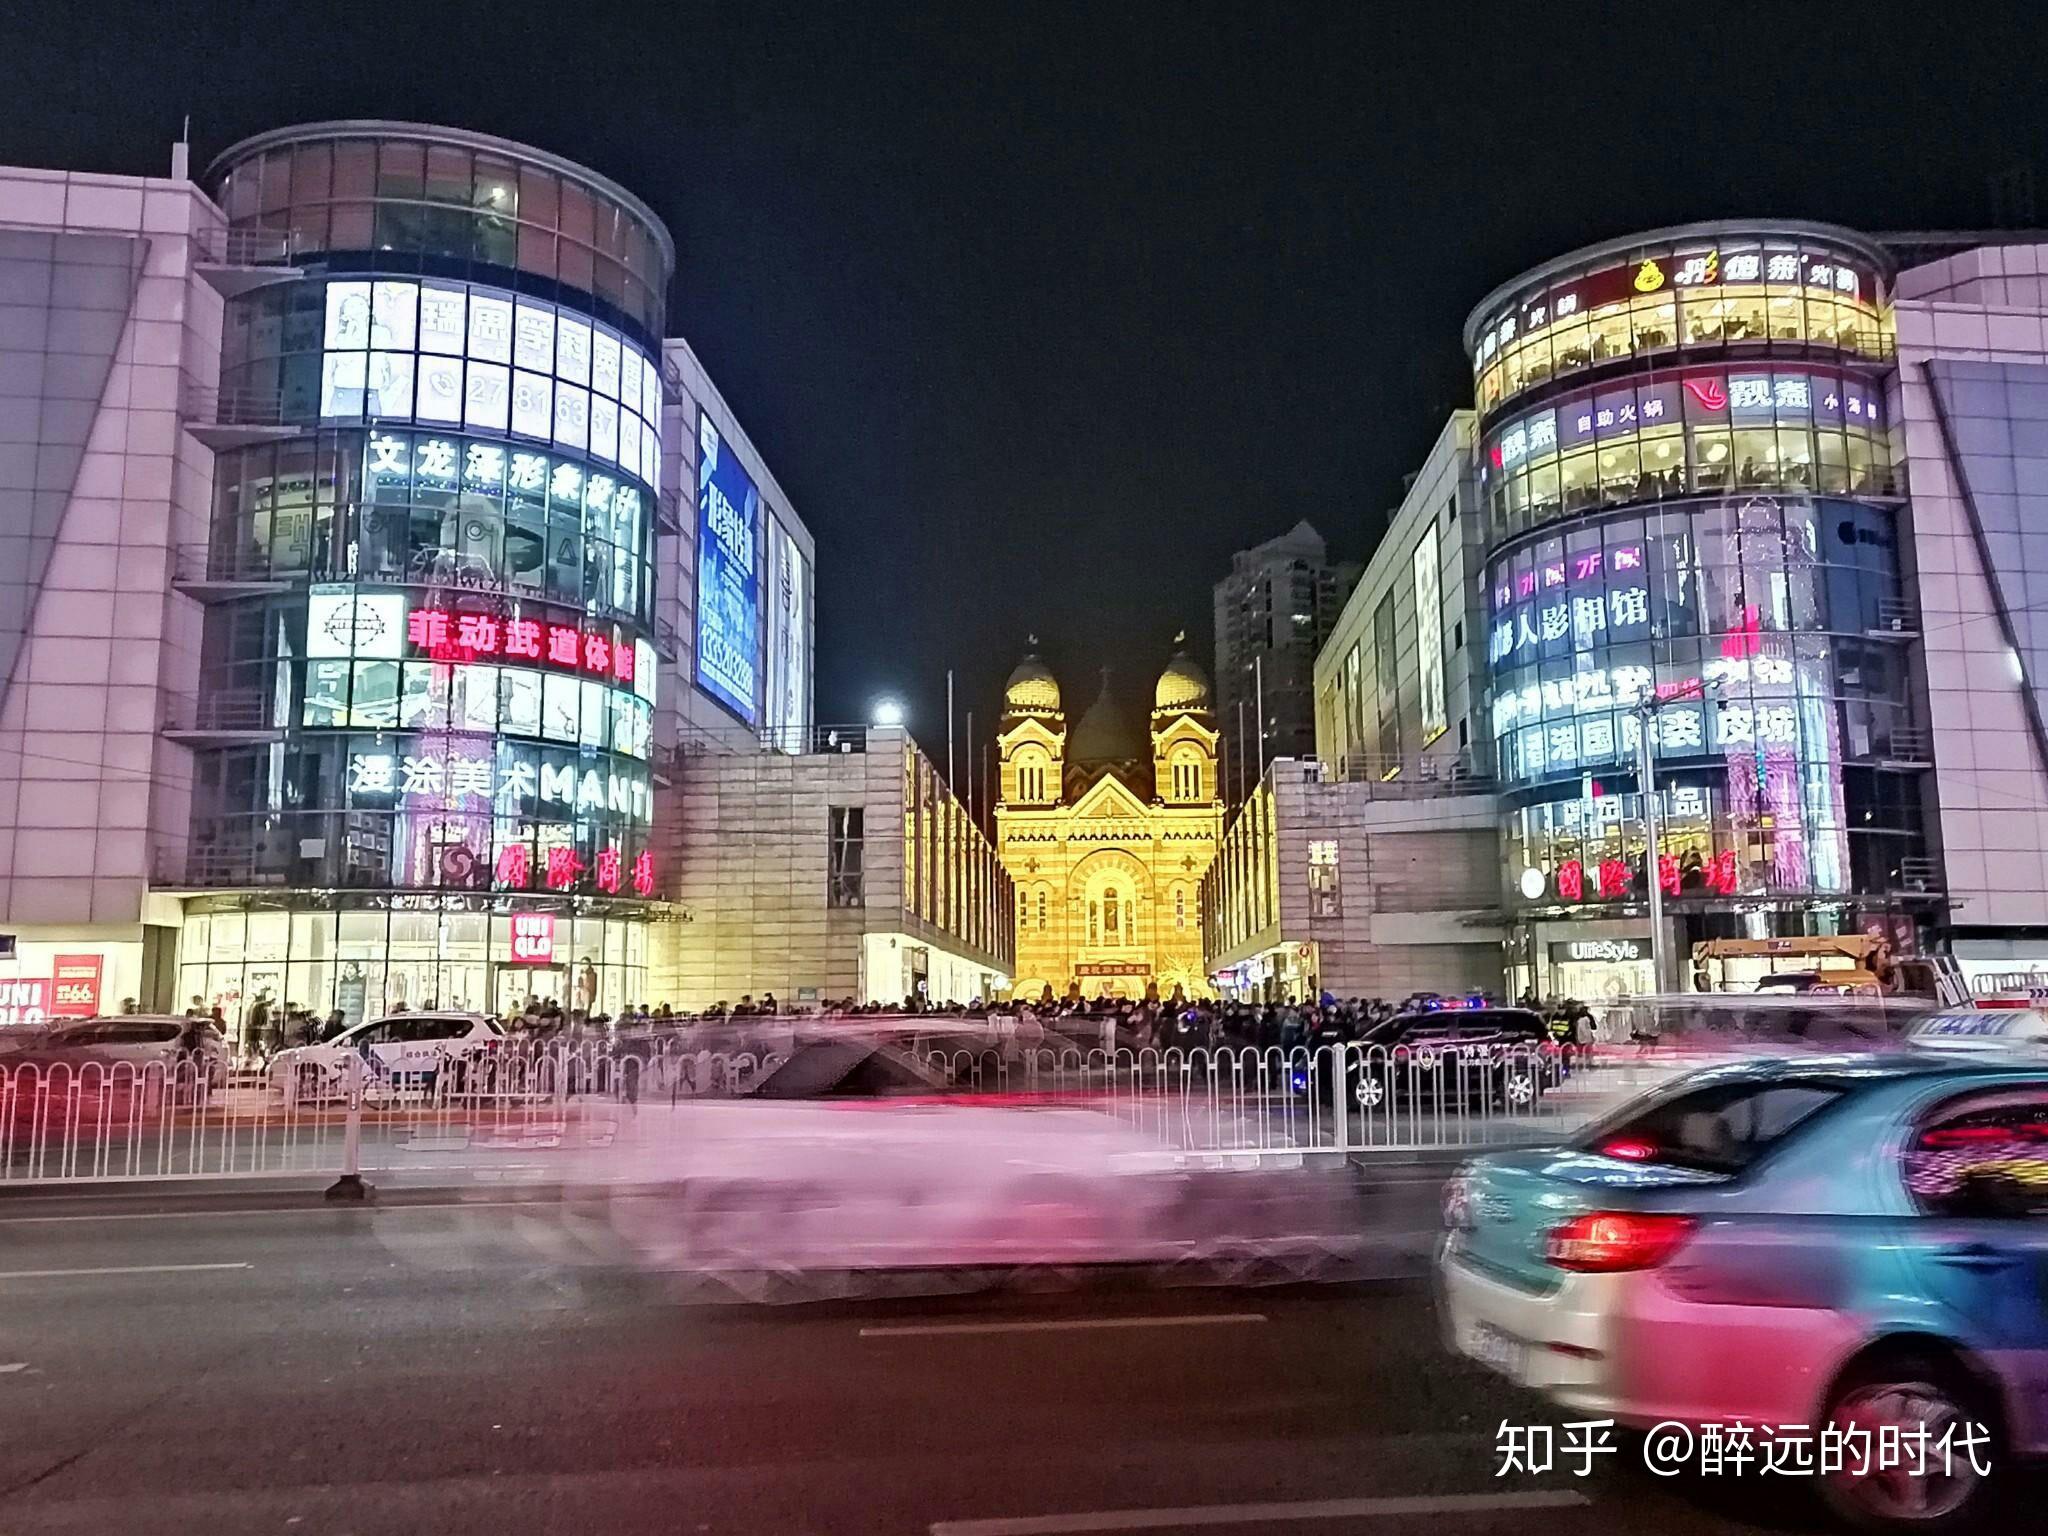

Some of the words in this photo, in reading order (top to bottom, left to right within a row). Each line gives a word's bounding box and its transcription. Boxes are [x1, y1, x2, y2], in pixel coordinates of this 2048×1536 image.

[1577, 400, 1665, 433] 自助火锅
[1490, 587, 1648, 664] 人影相馆
[408, 611, 635, 680] 菲动武道体能
[515, 916, 549, 937] UNI
[514, 936, 551, 958] QLO
